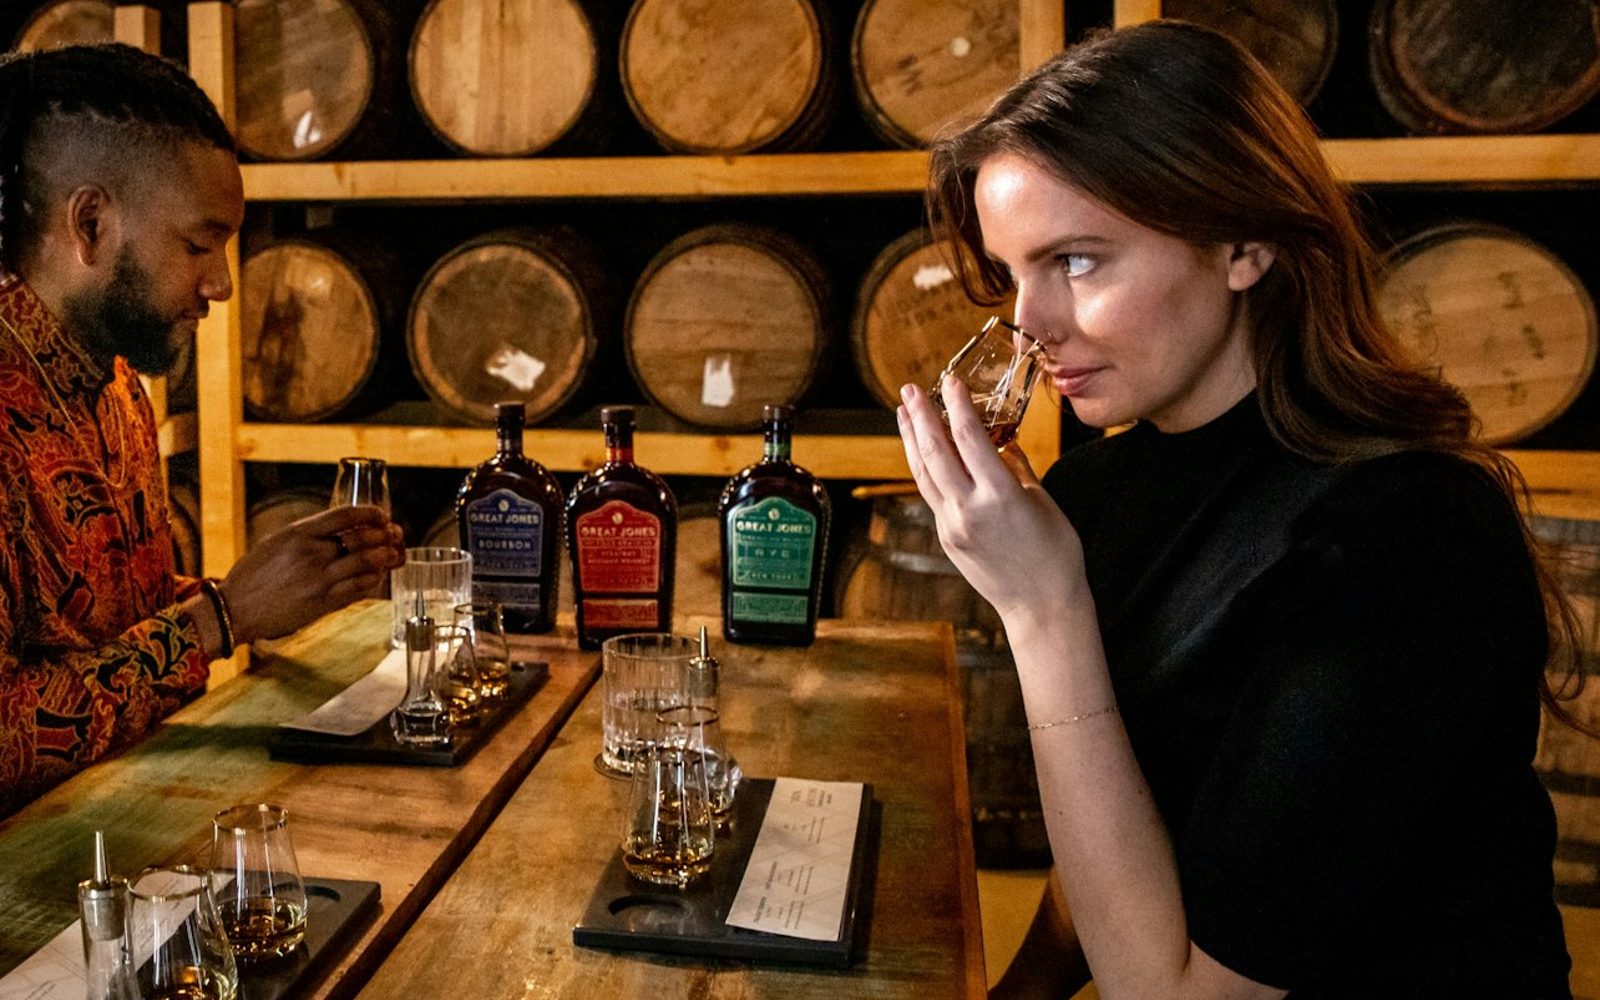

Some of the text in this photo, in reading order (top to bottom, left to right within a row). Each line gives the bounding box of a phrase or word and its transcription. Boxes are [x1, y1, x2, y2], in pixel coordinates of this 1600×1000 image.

[470, 512, 539, 525] GREAT JONES
[580, 526, 656, 537] GREAT JONES
[736, 520, 811, 534] GREAT JONES
[478, 539, 532, 551] BOURBON
